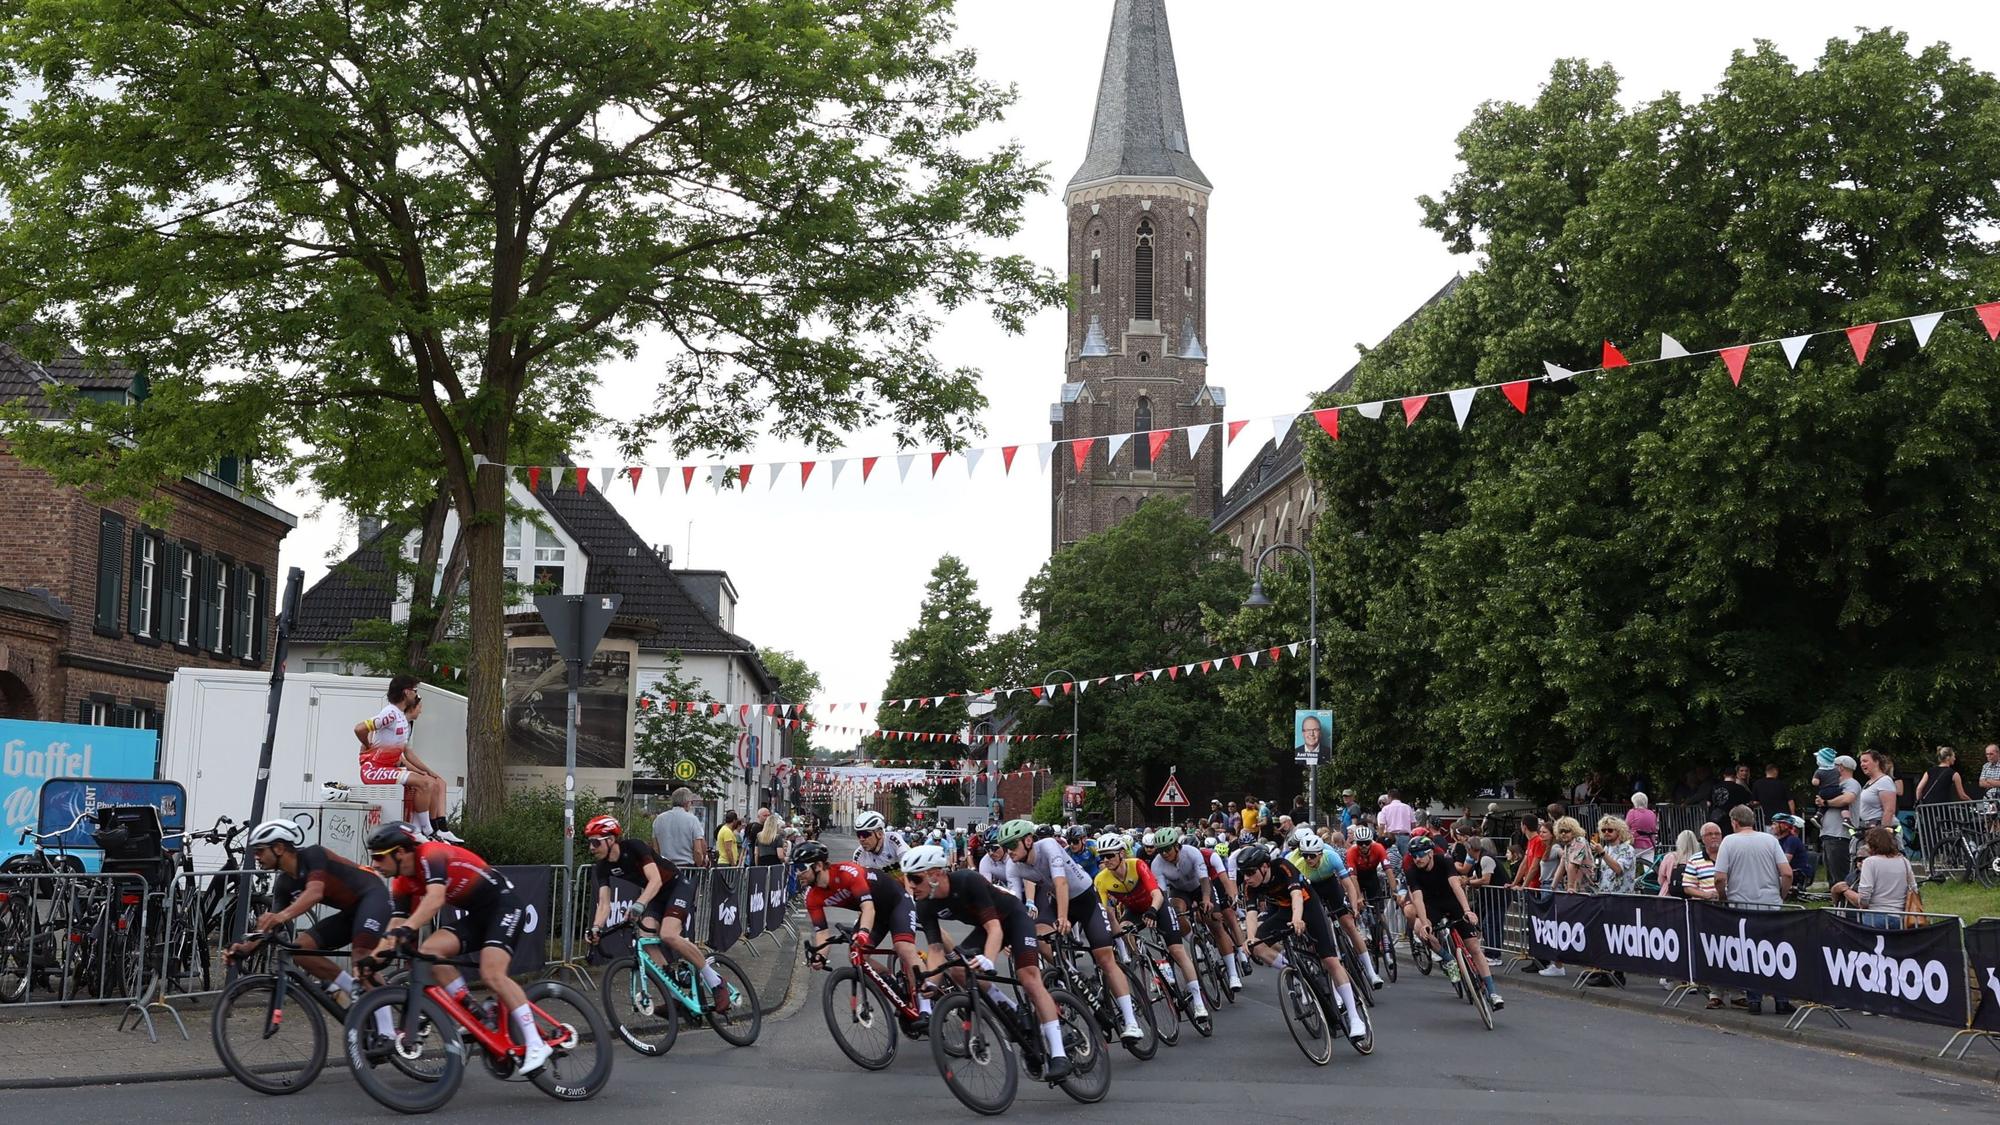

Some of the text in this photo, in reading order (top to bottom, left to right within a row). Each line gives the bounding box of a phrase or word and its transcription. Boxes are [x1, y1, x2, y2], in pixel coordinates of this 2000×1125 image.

[1604, 908, 1679, 963] wahoo
[1699, 918, 1797, 980] wahoo
[1822, 935, 1949, 1004] wahoo
[567, 1086, 587, 1096] SWISS
